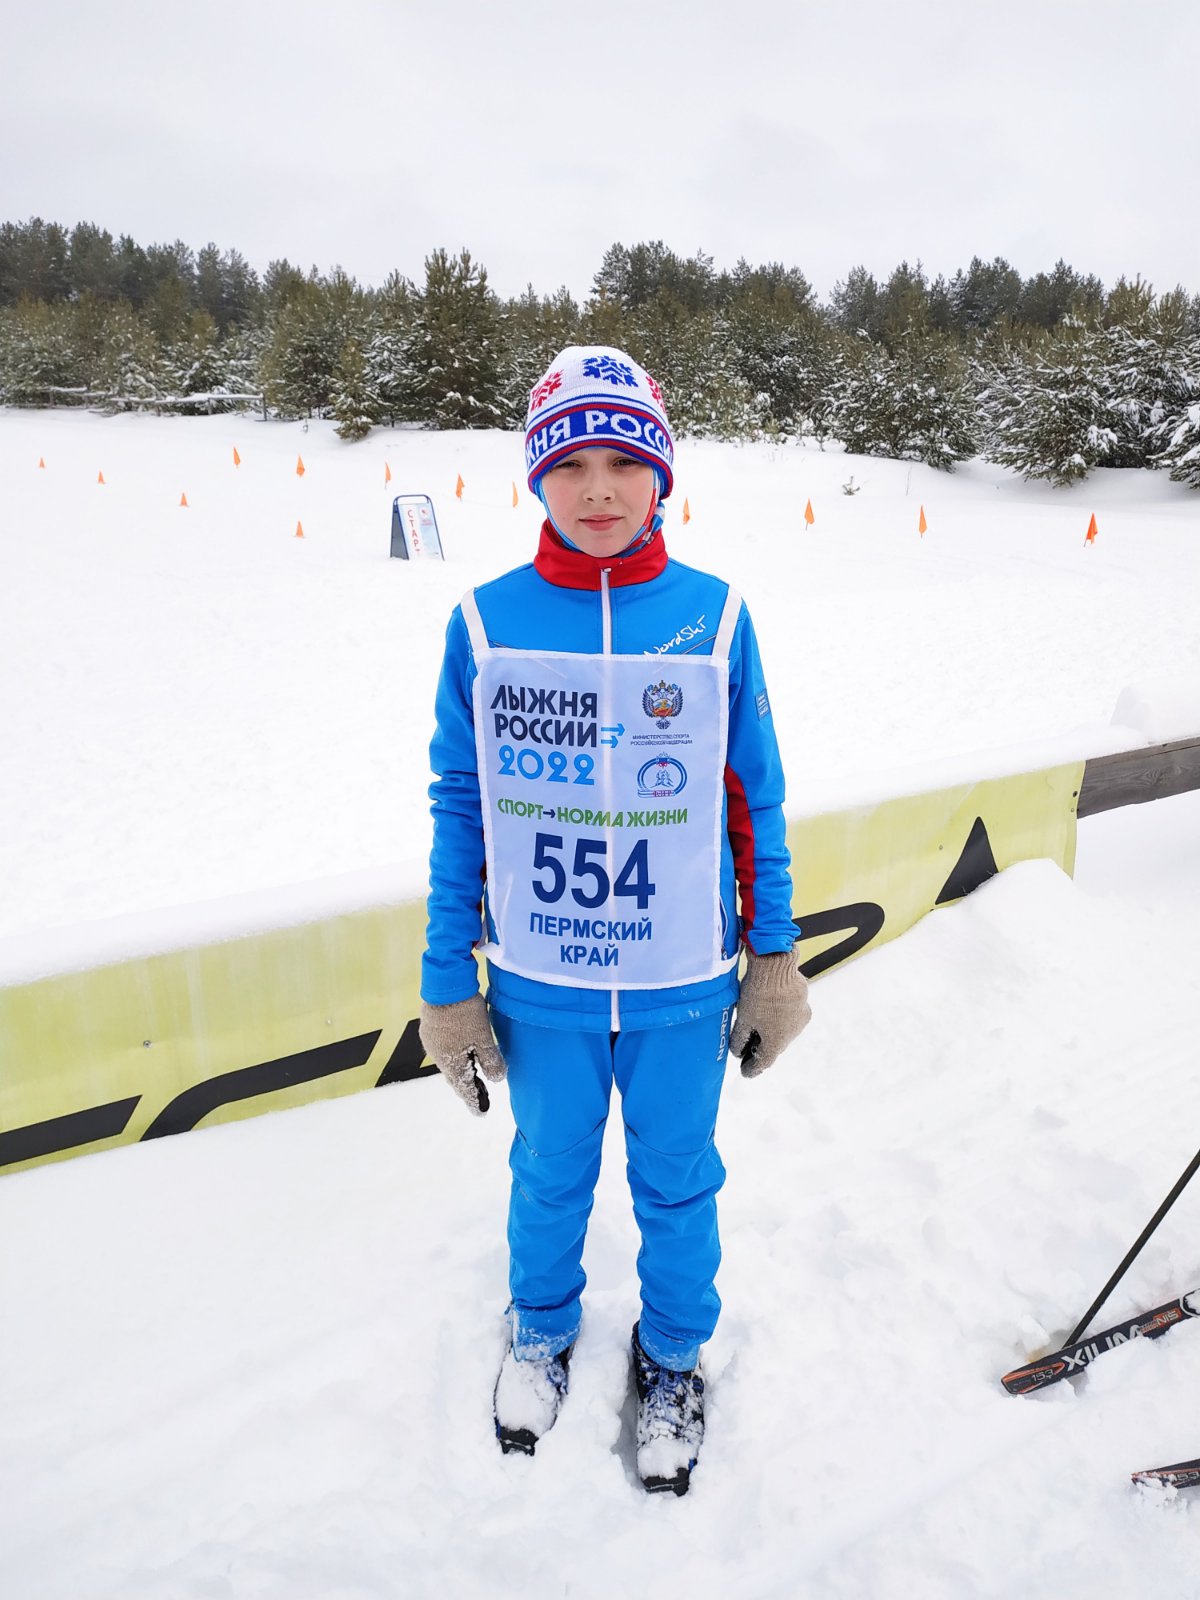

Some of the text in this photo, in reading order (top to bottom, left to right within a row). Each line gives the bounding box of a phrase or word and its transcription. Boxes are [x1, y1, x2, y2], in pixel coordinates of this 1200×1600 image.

[490, 684, 598, 718] ЛЫЖНЯ
[494, 713, 597, 748] РОССИИ
[497, 744, 595, 786] 2022
[498, 798, 688, 828] СПОРТ НОРМА ЖИЗНИ
[531, 832, 656, 910] 554
[529, 911, 652, 941] ПЕРМСКИЙ
[560, 943, 619, 967] КРАЙ
